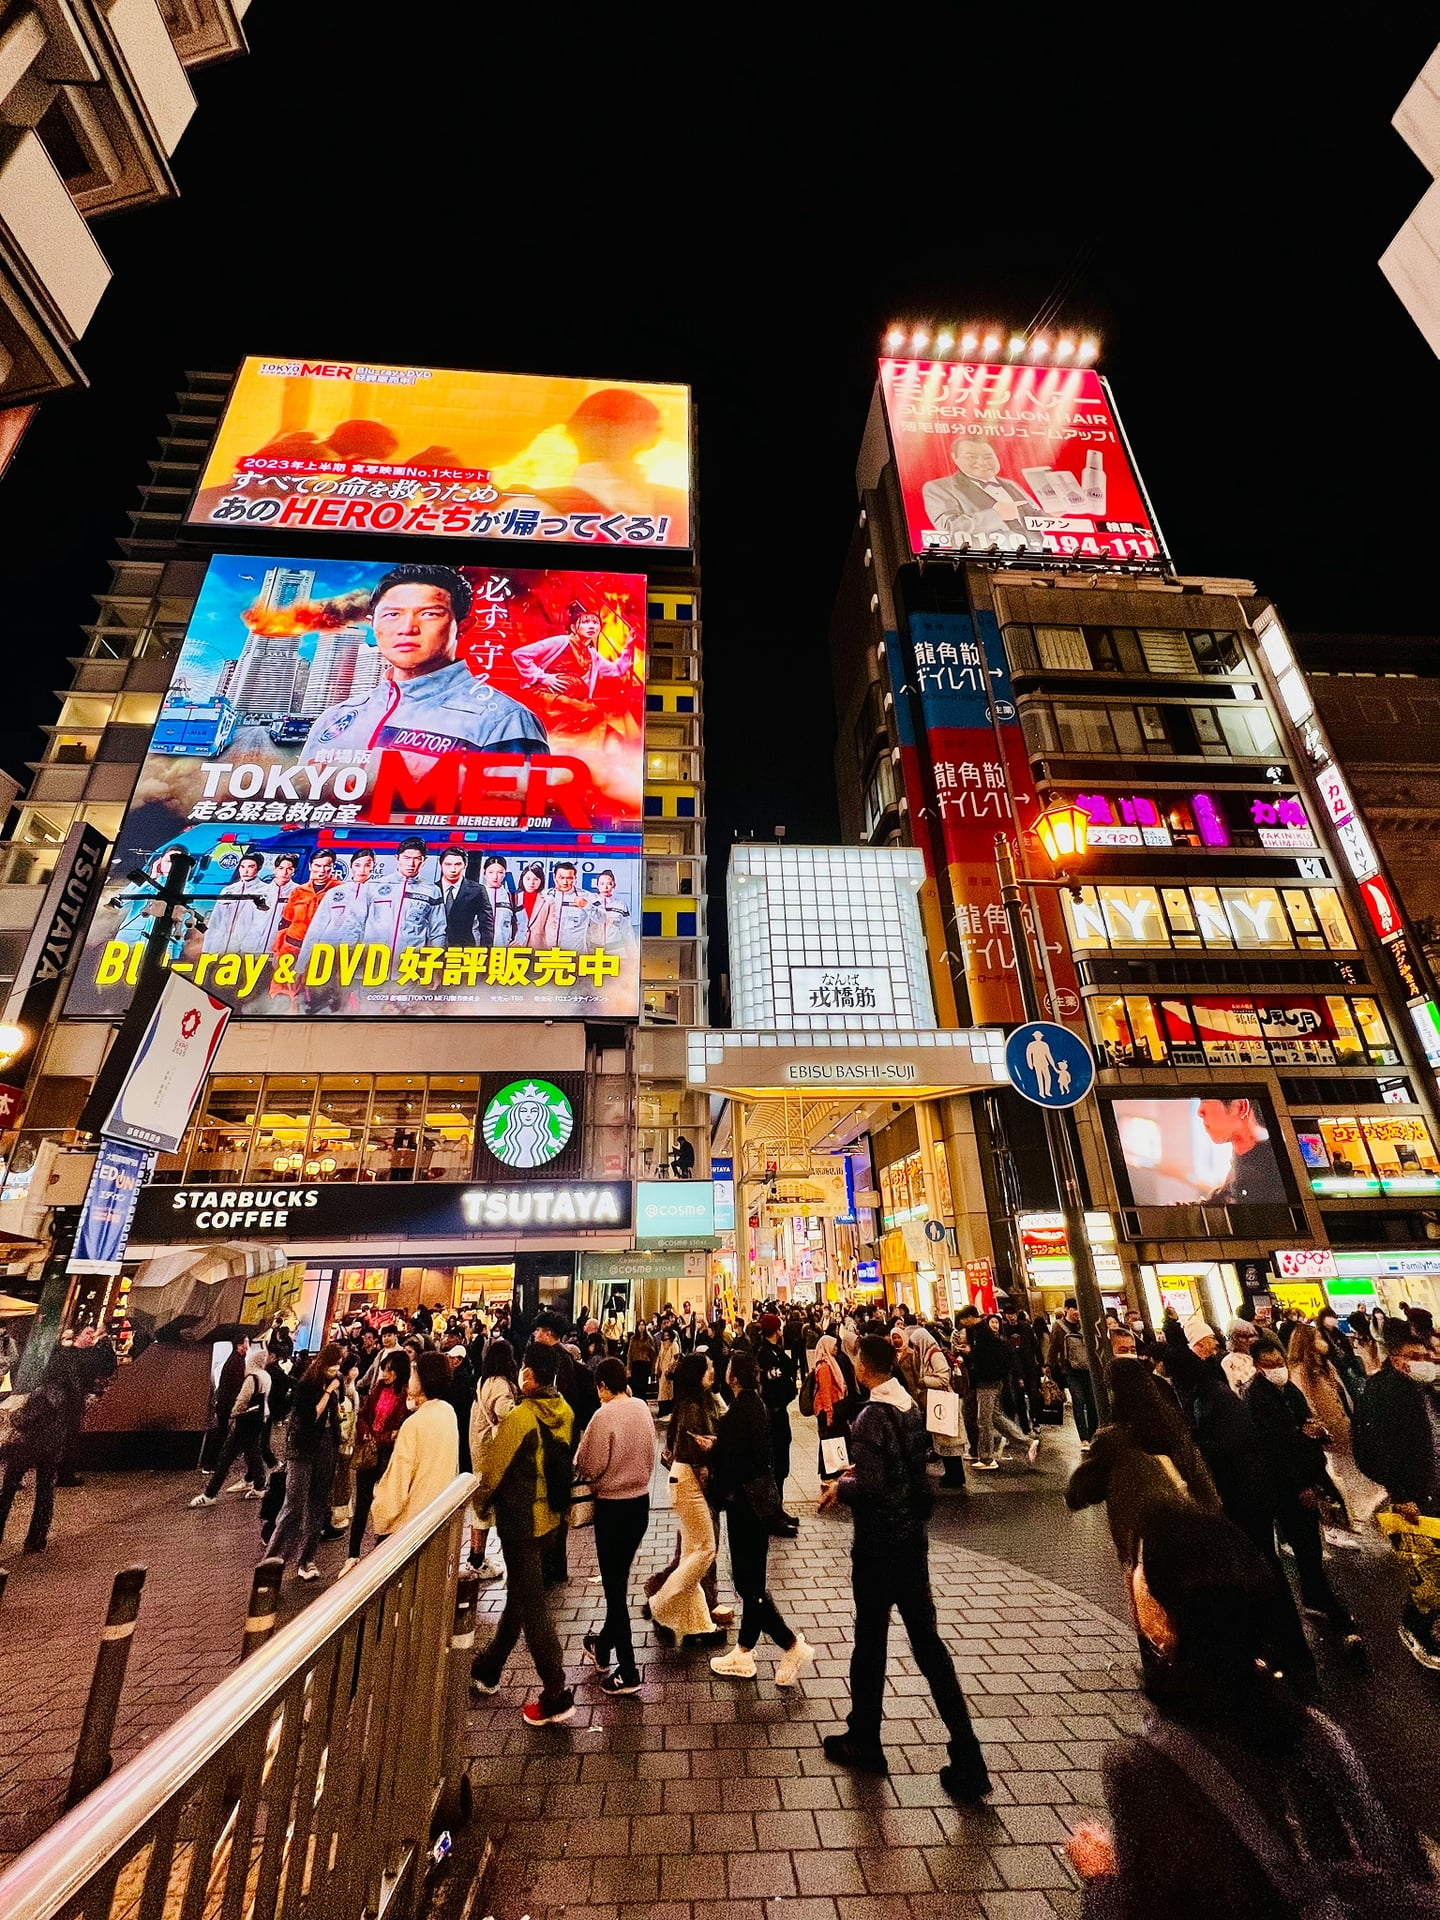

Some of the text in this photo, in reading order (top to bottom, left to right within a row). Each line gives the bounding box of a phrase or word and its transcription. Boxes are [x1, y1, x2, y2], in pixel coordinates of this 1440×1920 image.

[261, 363, 300, 373] TOKYO
[301, 363, 353, 380] MER
[897, 404, 967, 418] SUPER
[974, 408, 1050, 422] MILLION
[243, 458, 492, 481] 2023年上半期 実写映画No.1大ヒット!
[213, 496, 670, 543] あのHEROたちが帰ってくる!
[1031, 519, 1071, 529] ルアン
[952, 529, 1155, 558] 0120-494-111
[469, 575, 512, 711] 必ず、守る。
[914, 641, 983, 666] 龍角散
[395, 730, 453, 754] DOCTOR
[314, 747, 371, 764] 劇場版
[933, 761, 1007, 789] 龍角散
[200, 750, 593, 829] TOKYO MER
[187, 800, 363, 825] 走る緊急救命室
[449, 815, 518, 828] MERGENCY
[36, 842, 101, 979] TSUTAYA
[1070, 899, 1273, 940] NY NY
[97, 940, 621, 997] Bl-ray & DVD 好評販売中
[821, 972, 860, 987] なんば
[809, 986, 877, 1009] 戎橋筋
[171, 1189, 319, 1210] STARBUCKS
[463, 1190, 619, 1223] TSUTAYA
[645, 1203, 706, 1217] @cosme
[194, 1210, 288, 1229] COFFEE
[609, 1264, 652, 1275] @cosme
[689, 1256, 702, 1267] 3F
